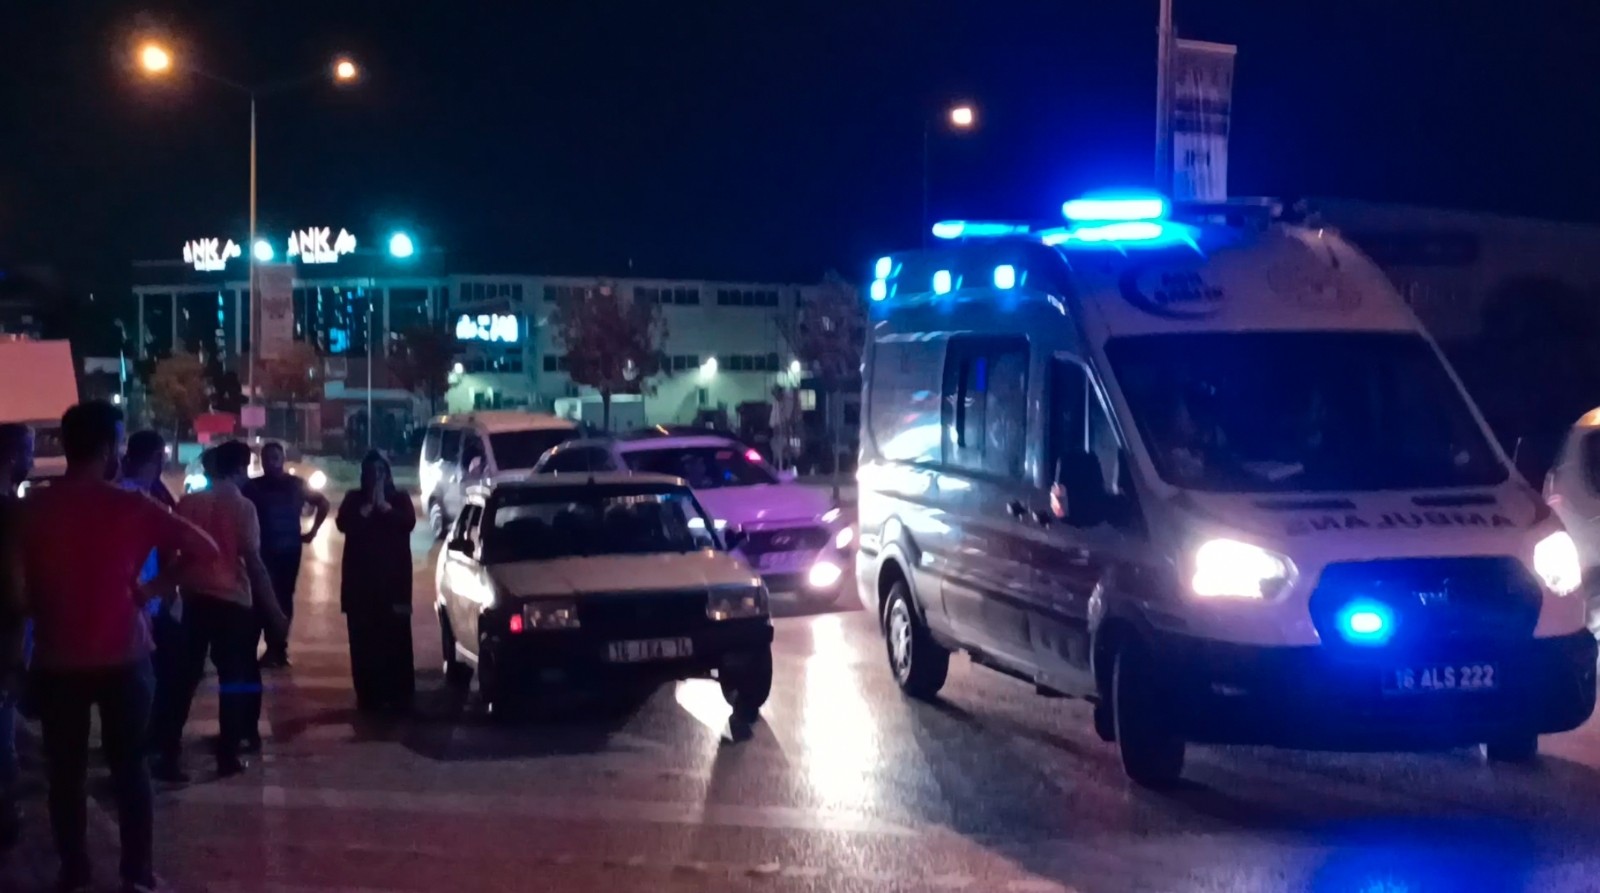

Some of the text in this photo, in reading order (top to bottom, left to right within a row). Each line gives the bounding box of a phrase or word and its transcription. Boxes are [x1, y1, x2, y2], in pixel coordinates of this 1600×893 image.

[1395, 664, 1494, 690] 16 ALS 222
